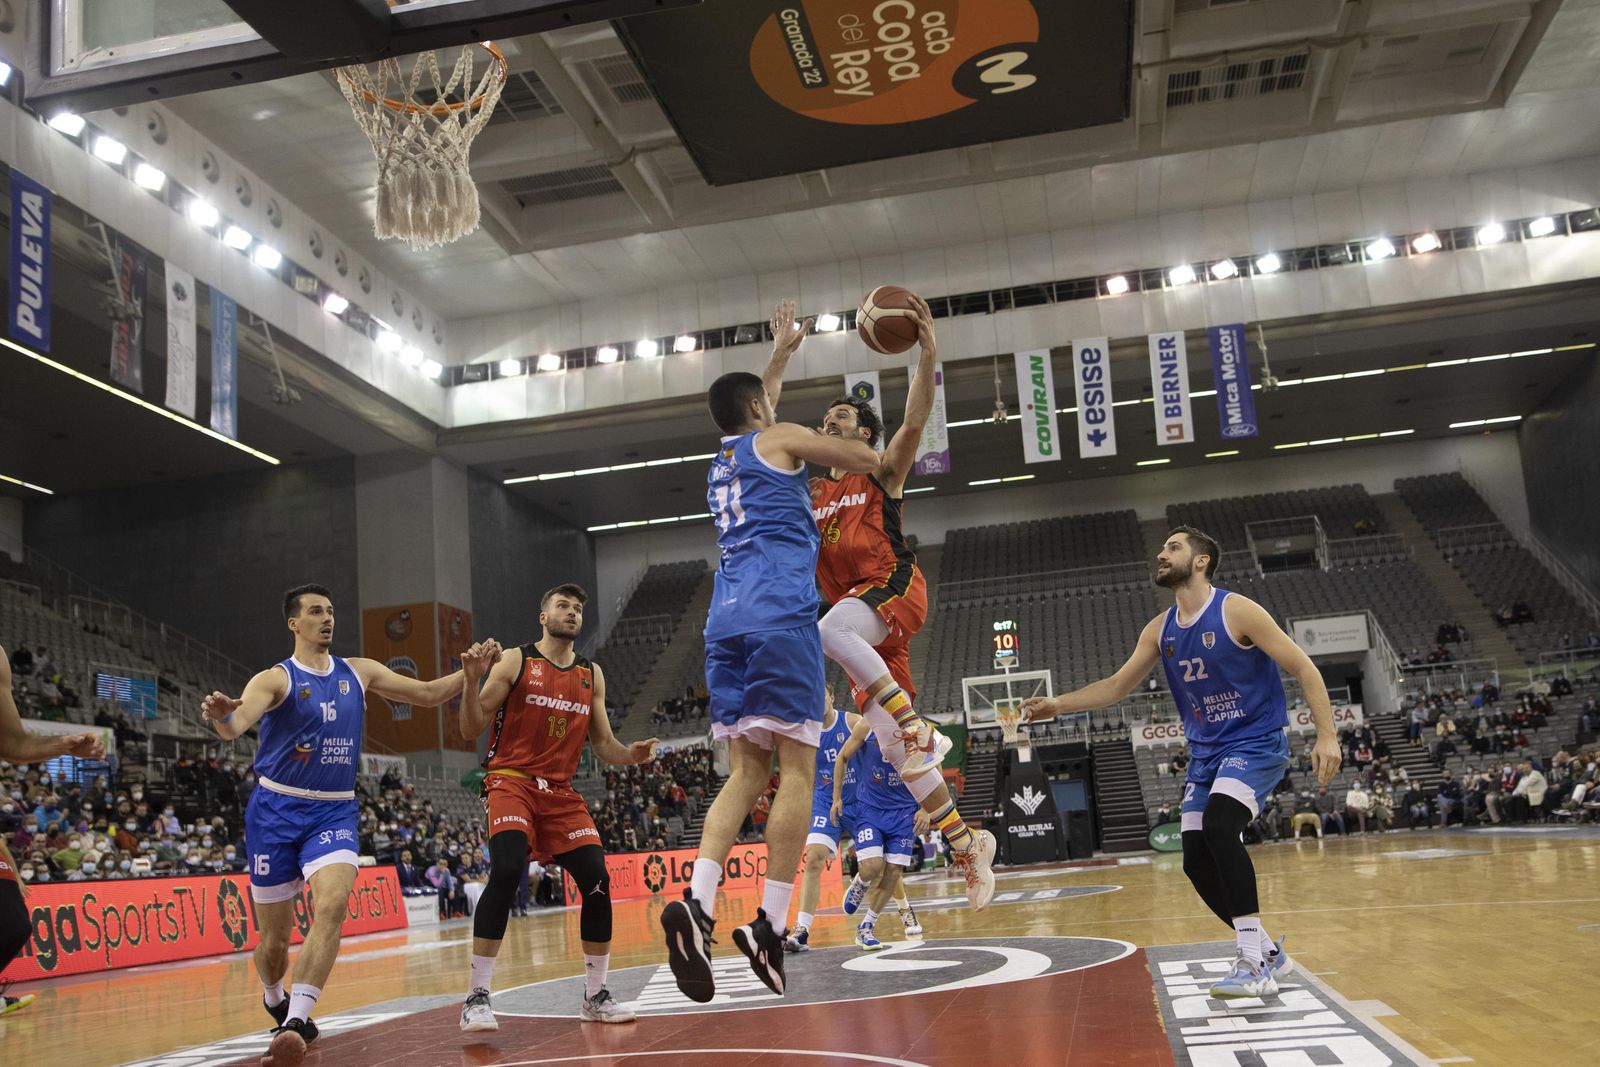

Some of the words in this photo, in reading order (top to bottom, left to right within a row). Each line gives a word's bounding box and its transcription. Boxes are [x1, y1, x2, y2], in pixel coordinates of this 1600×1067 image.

[779, 8, 813, 70] Granada
[838, 13, 868, 46] del
[871, 0, 921, 82] Copa
[921, 9, 951, 55] acb
[830, 49, 874, 97] Rey
[16, 192, 46, 341] PULEVA
[1219, 328, 1241, 379] Motor
[1159, 336, 1183, 419] BERNER
[1222, 383, 1243, 425] Mica
[993, 633, 1013, 649] 10
[1178, 657, 1209, 682] 22
[1203, 690, 1242, 705] MELILLA
[1205, 700, 1237, 715] SPORT
[320, 702, 337, 723] 16
[1207, 709, 1247, 723] CAPITAL
[547, 715, 568, 738] 13
[824, 749, 838, 763] 13
[1183, 782, 1196, 802] 2
[813, 815, 828, 829] 13
[857, 827, 874, 843] 88
[253, 854, 270, 876] 16
